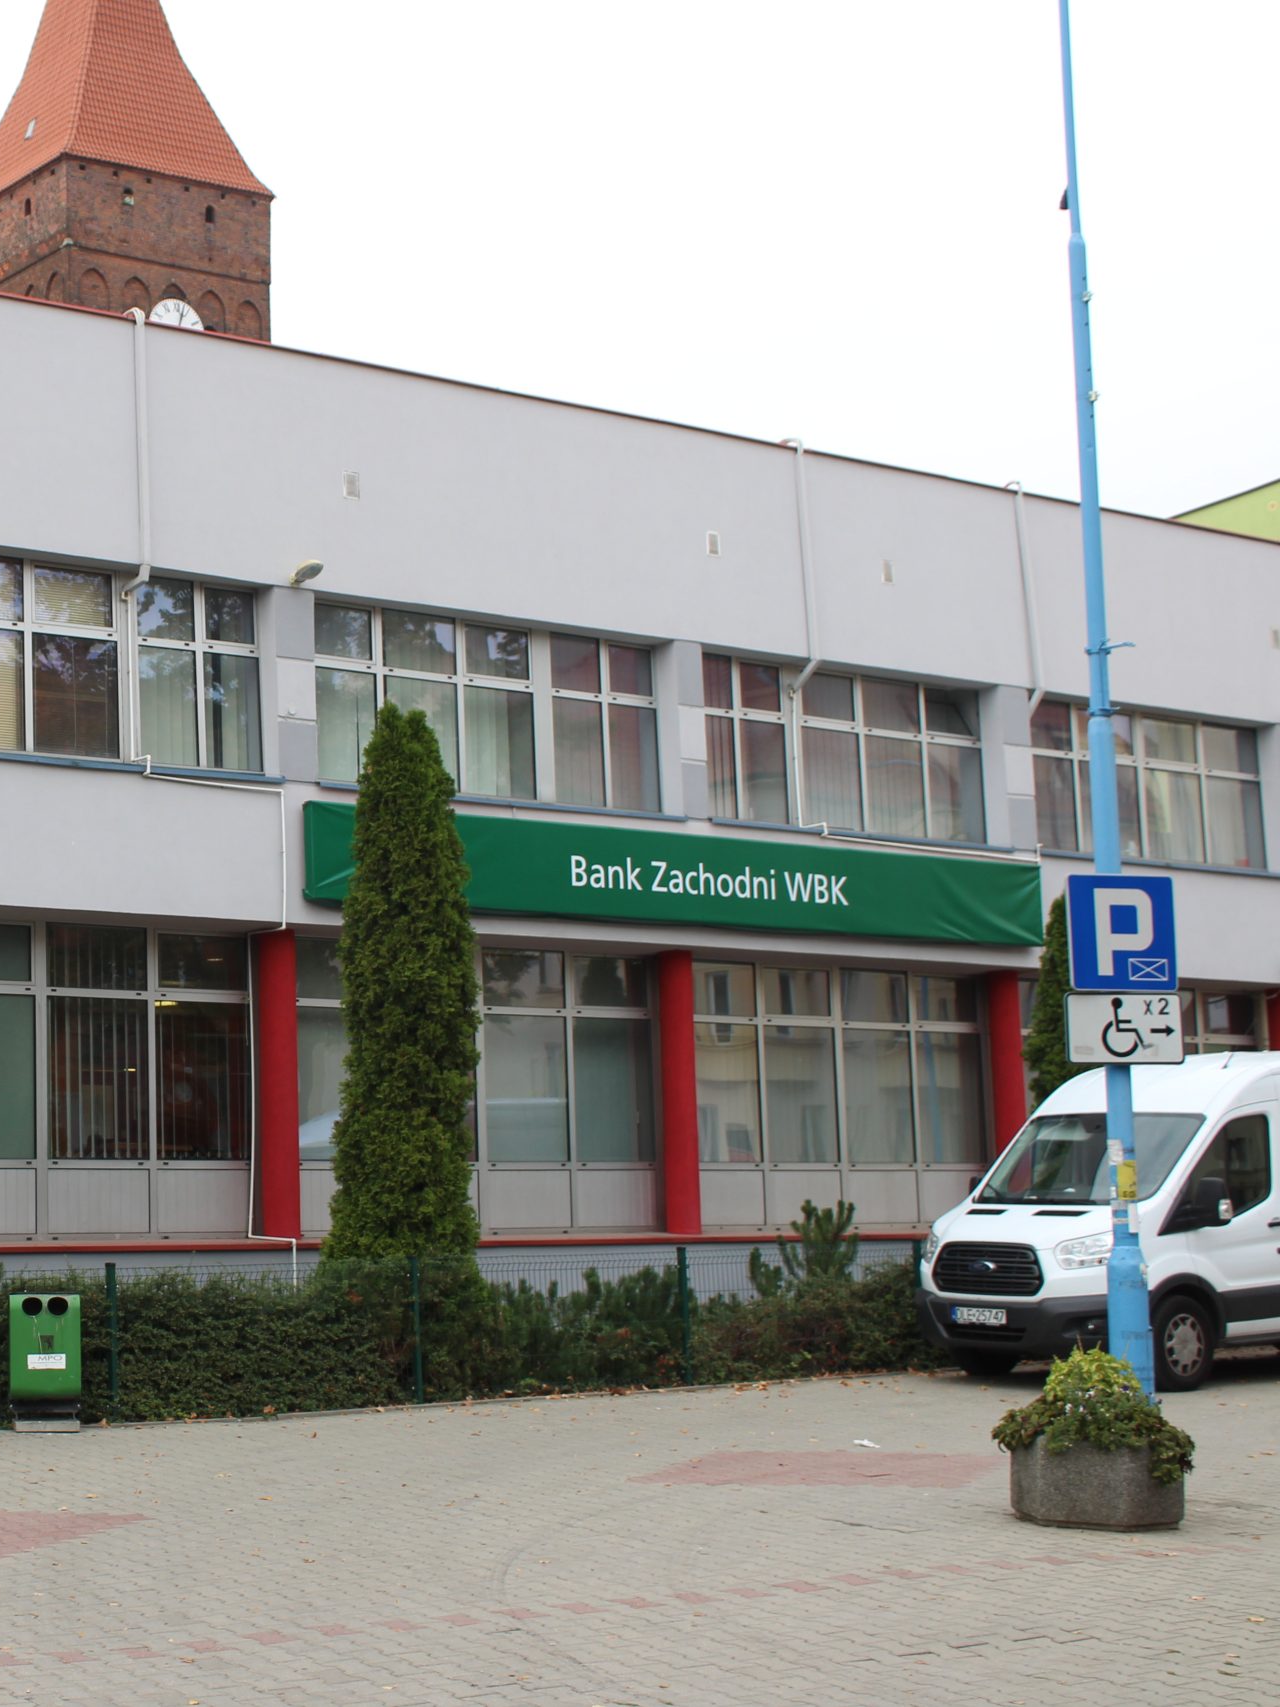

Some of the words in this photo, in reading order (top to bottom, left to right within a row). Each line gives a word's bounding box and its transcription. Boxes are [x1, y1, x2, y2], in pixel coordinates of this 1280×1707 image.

[570, 854, 643, 891] Bank
[650, 860, 776, 901] Zachodni
[783, 871, 849, 907] WBK
[1092, 887, 1154, 976] P
